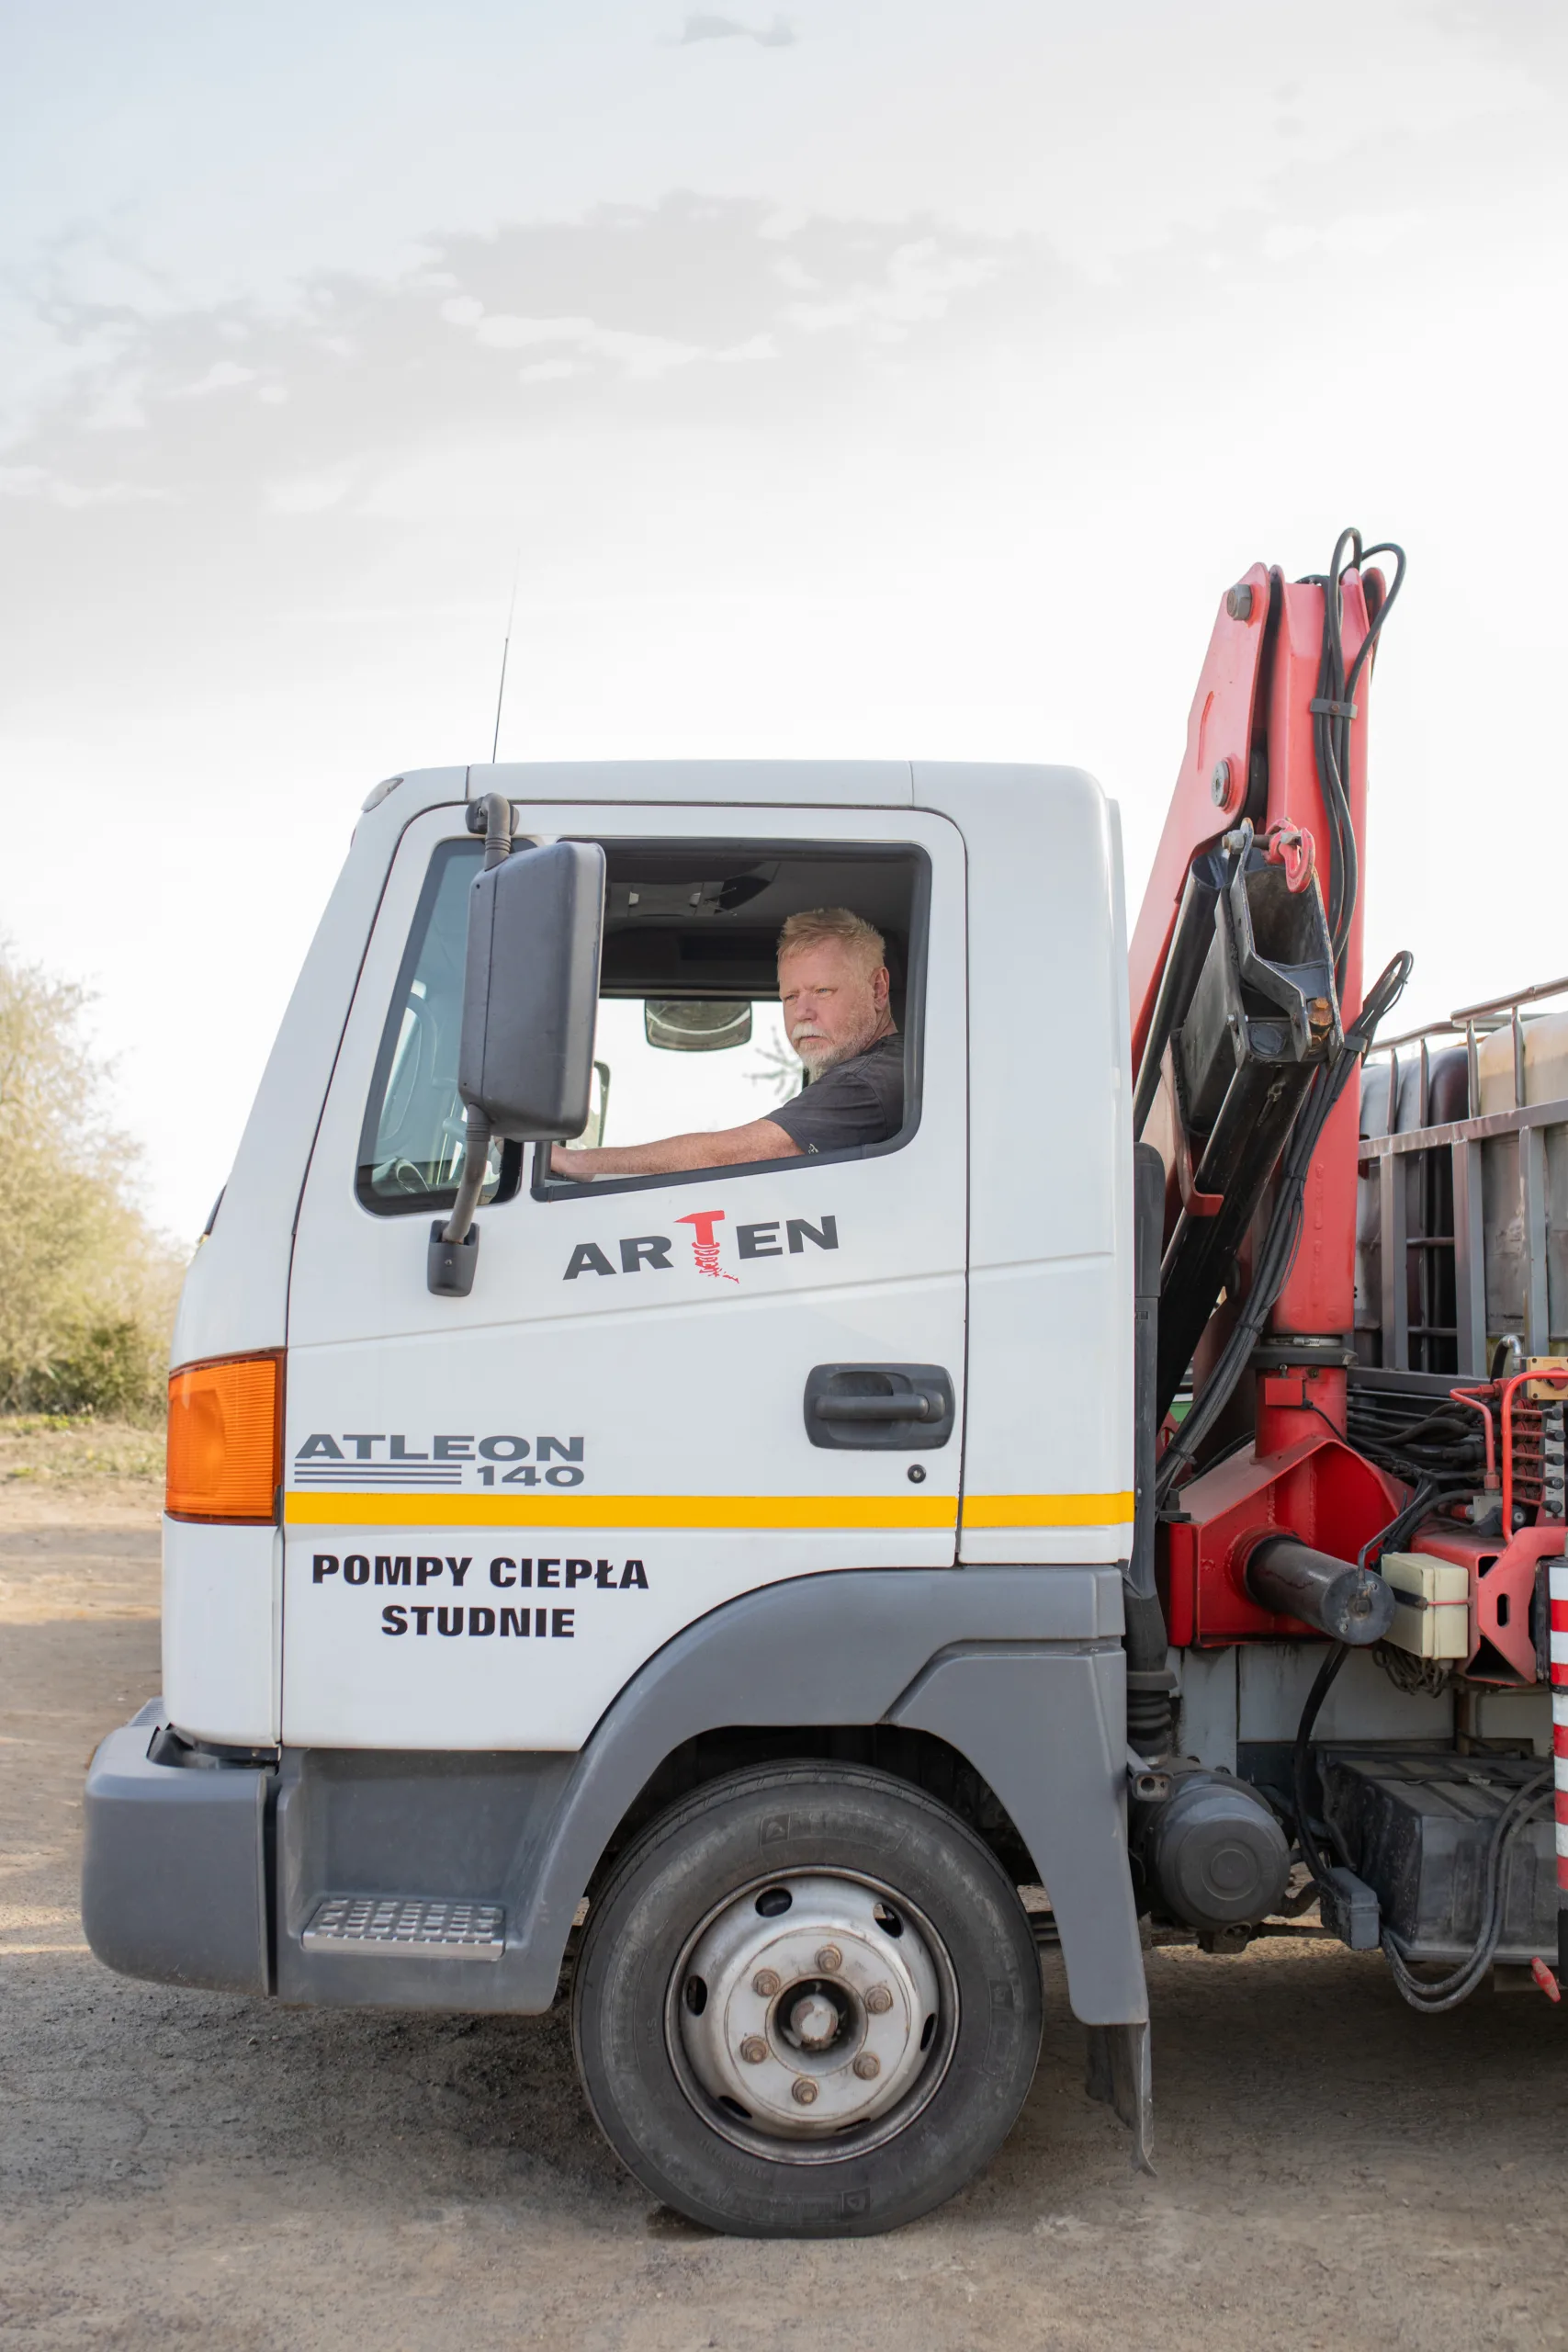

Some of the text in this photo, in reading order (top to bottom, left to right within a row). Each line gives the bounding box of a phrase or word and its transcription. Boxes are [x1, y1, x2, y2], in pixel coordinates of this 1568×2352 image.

[563, 1210, 840, 1283] ARTEN
[295, 1433, 584, 1462] ATLEON
[477, 1465, 585, 1487] 140
[312, 1554, 649, 1589] POMPY CIEPŁA
[381, 1604, 575, 1638] STUDNIE
